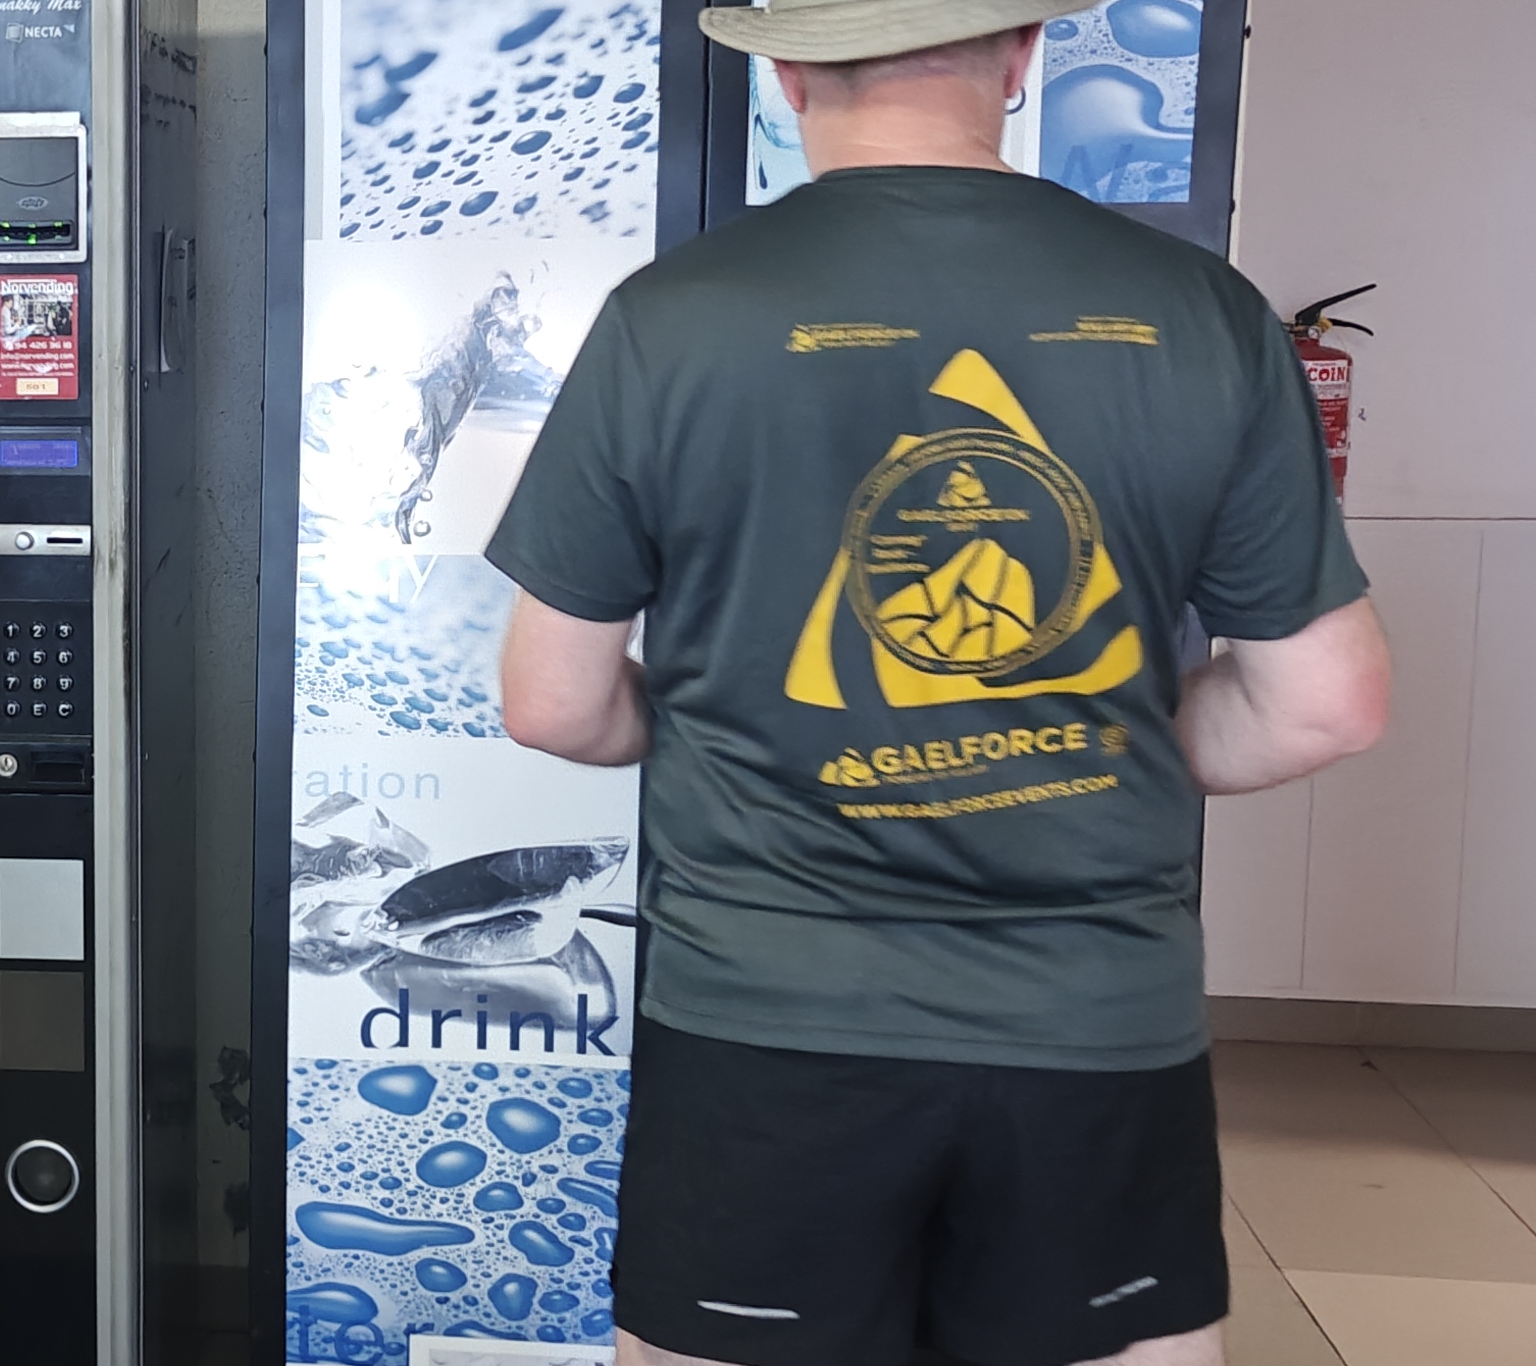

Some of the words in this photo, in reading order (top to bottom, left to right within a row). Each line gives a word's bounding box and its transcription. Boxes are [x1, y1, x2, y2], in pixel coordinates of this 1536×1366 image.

[24, 25, 63, 39] NECTA
[0, 279, 74, 296] Norvending
[6, 625, 15, 637] 1
[33, 625, 42, 637] 2
[59, 625, 69, 637] 3
[6, 651, 15, 663] 4
[33, 651, 42, 663] 5
[59, 651, 69, 663] 6
[6, 678, 15, 690] 7
[33, 678, 42, 690] 8
[59, 678, 69, 690] 9
[33, 704, 42, 716] E
[59, 704, 69, 716] C
[870, 722, 1089, 775] GAELFORCE
[359, 988, 620, 1057] drink
